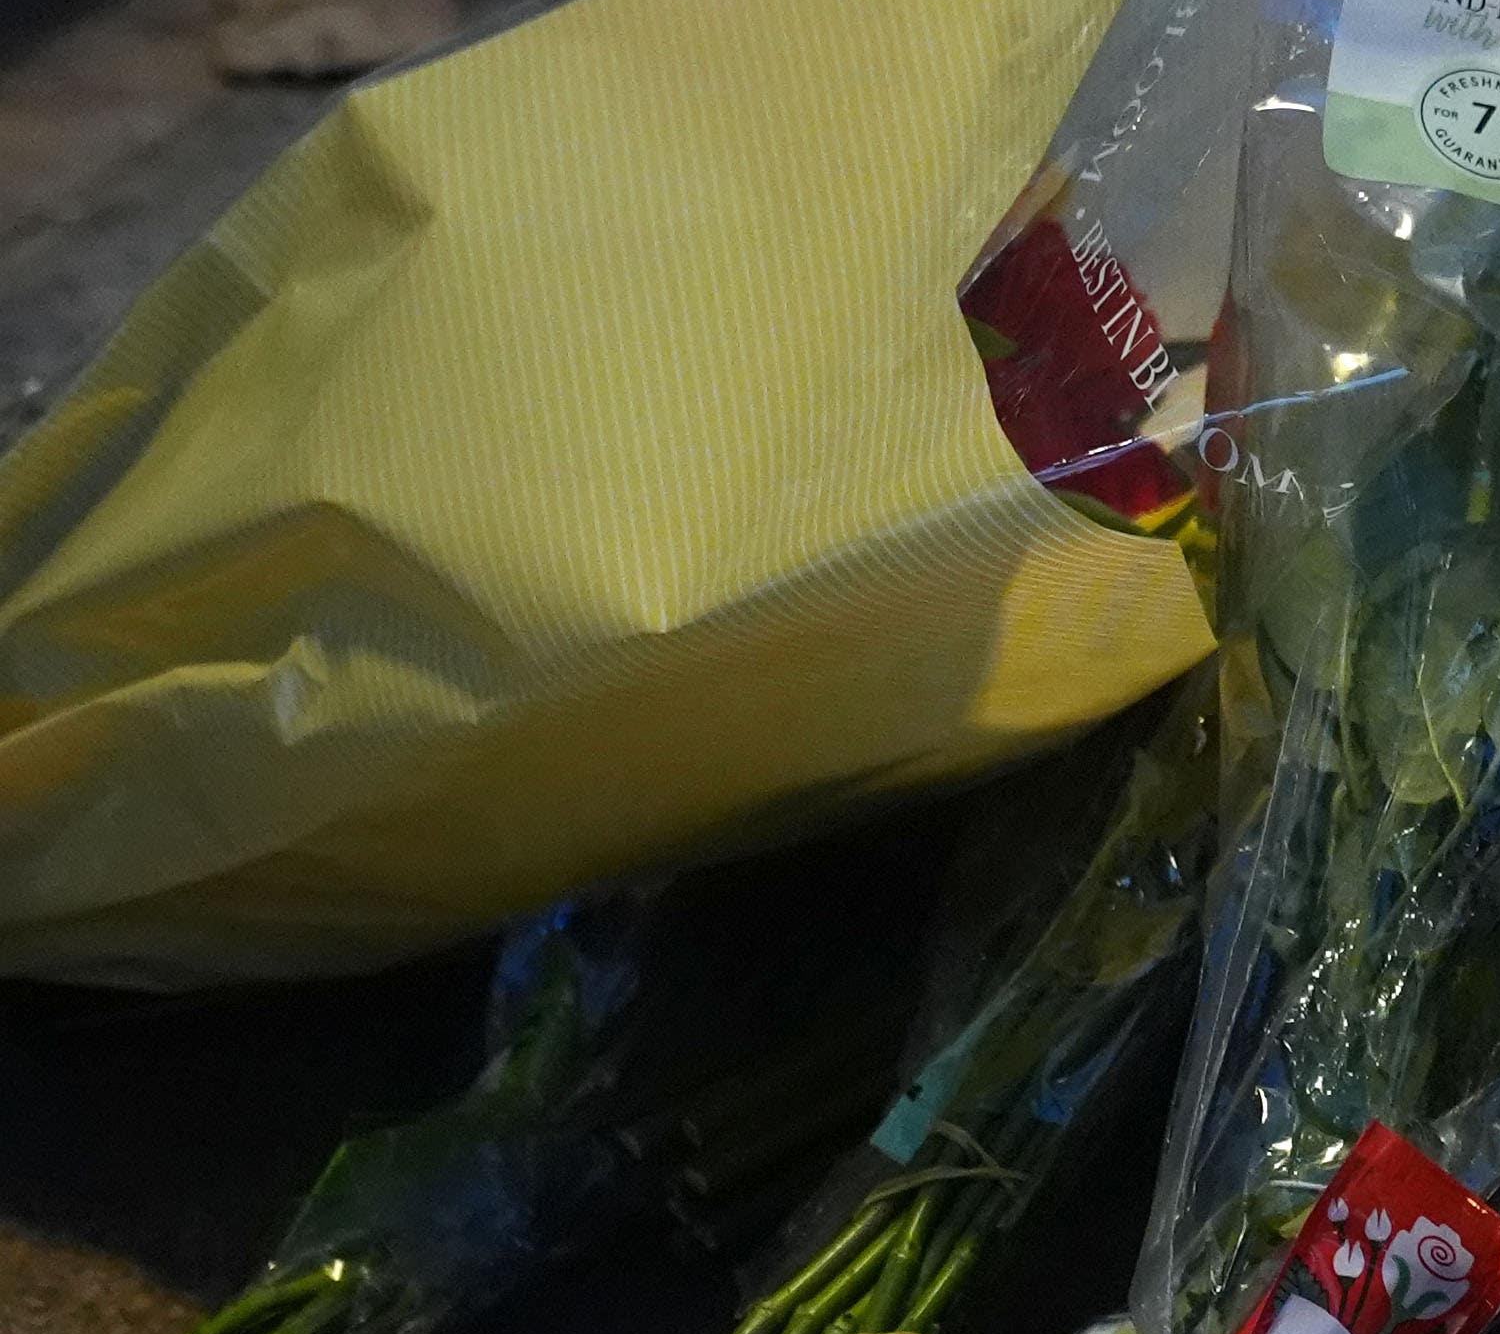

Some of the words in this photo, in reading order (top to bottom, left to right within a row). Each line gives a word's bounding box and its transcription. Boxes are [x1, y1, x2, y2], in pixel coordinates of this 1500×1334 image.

[1433, 107, 1460, 121] FOR
[1471, 101, 1498, 135] 7
[1070, 218, 1130, 315] BEST
[1101, 296, 1156, 361] IN
